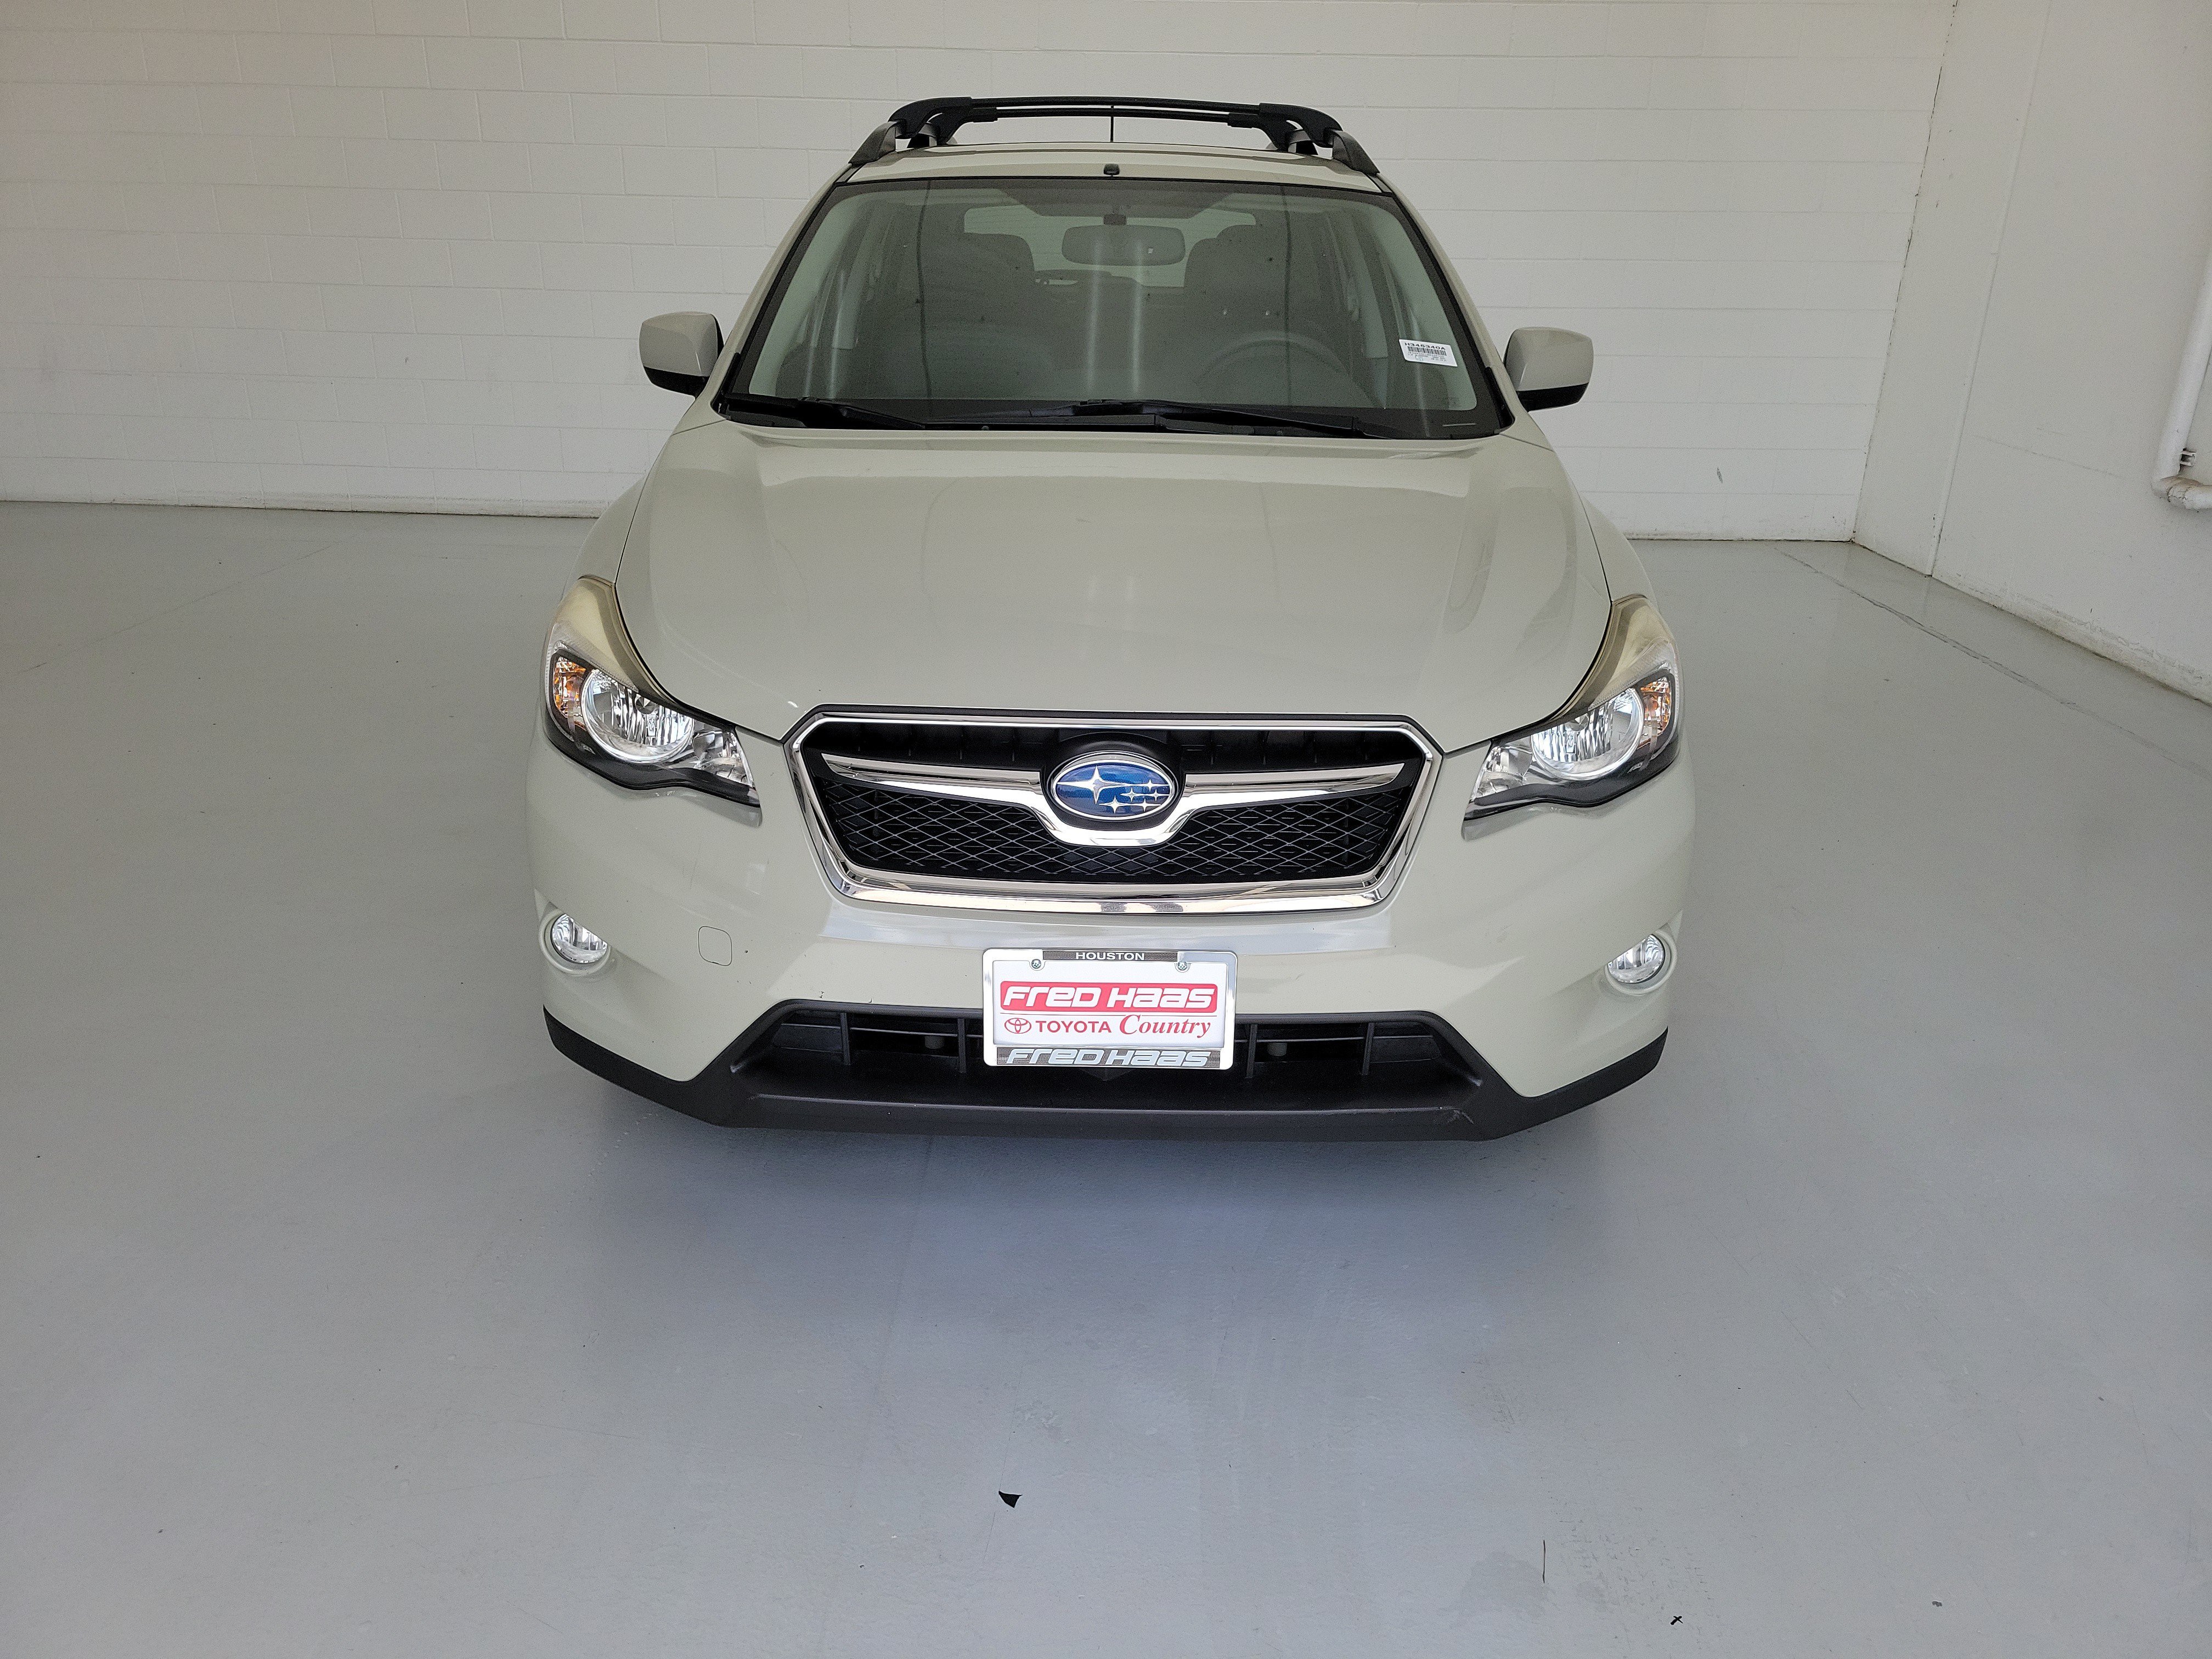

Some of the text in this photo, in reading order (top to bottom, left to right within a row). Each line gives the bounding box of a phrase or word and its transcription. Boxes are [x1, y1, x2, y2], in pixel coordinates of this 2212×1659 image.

[1075, 952, 1145, 960] HOUSTON
[1107, 988, 1215, 1008] Haas
[1035, 1014, 1211, 1038] TOYOTA Country
[1105, 1049, 1211, 1066] Haas
